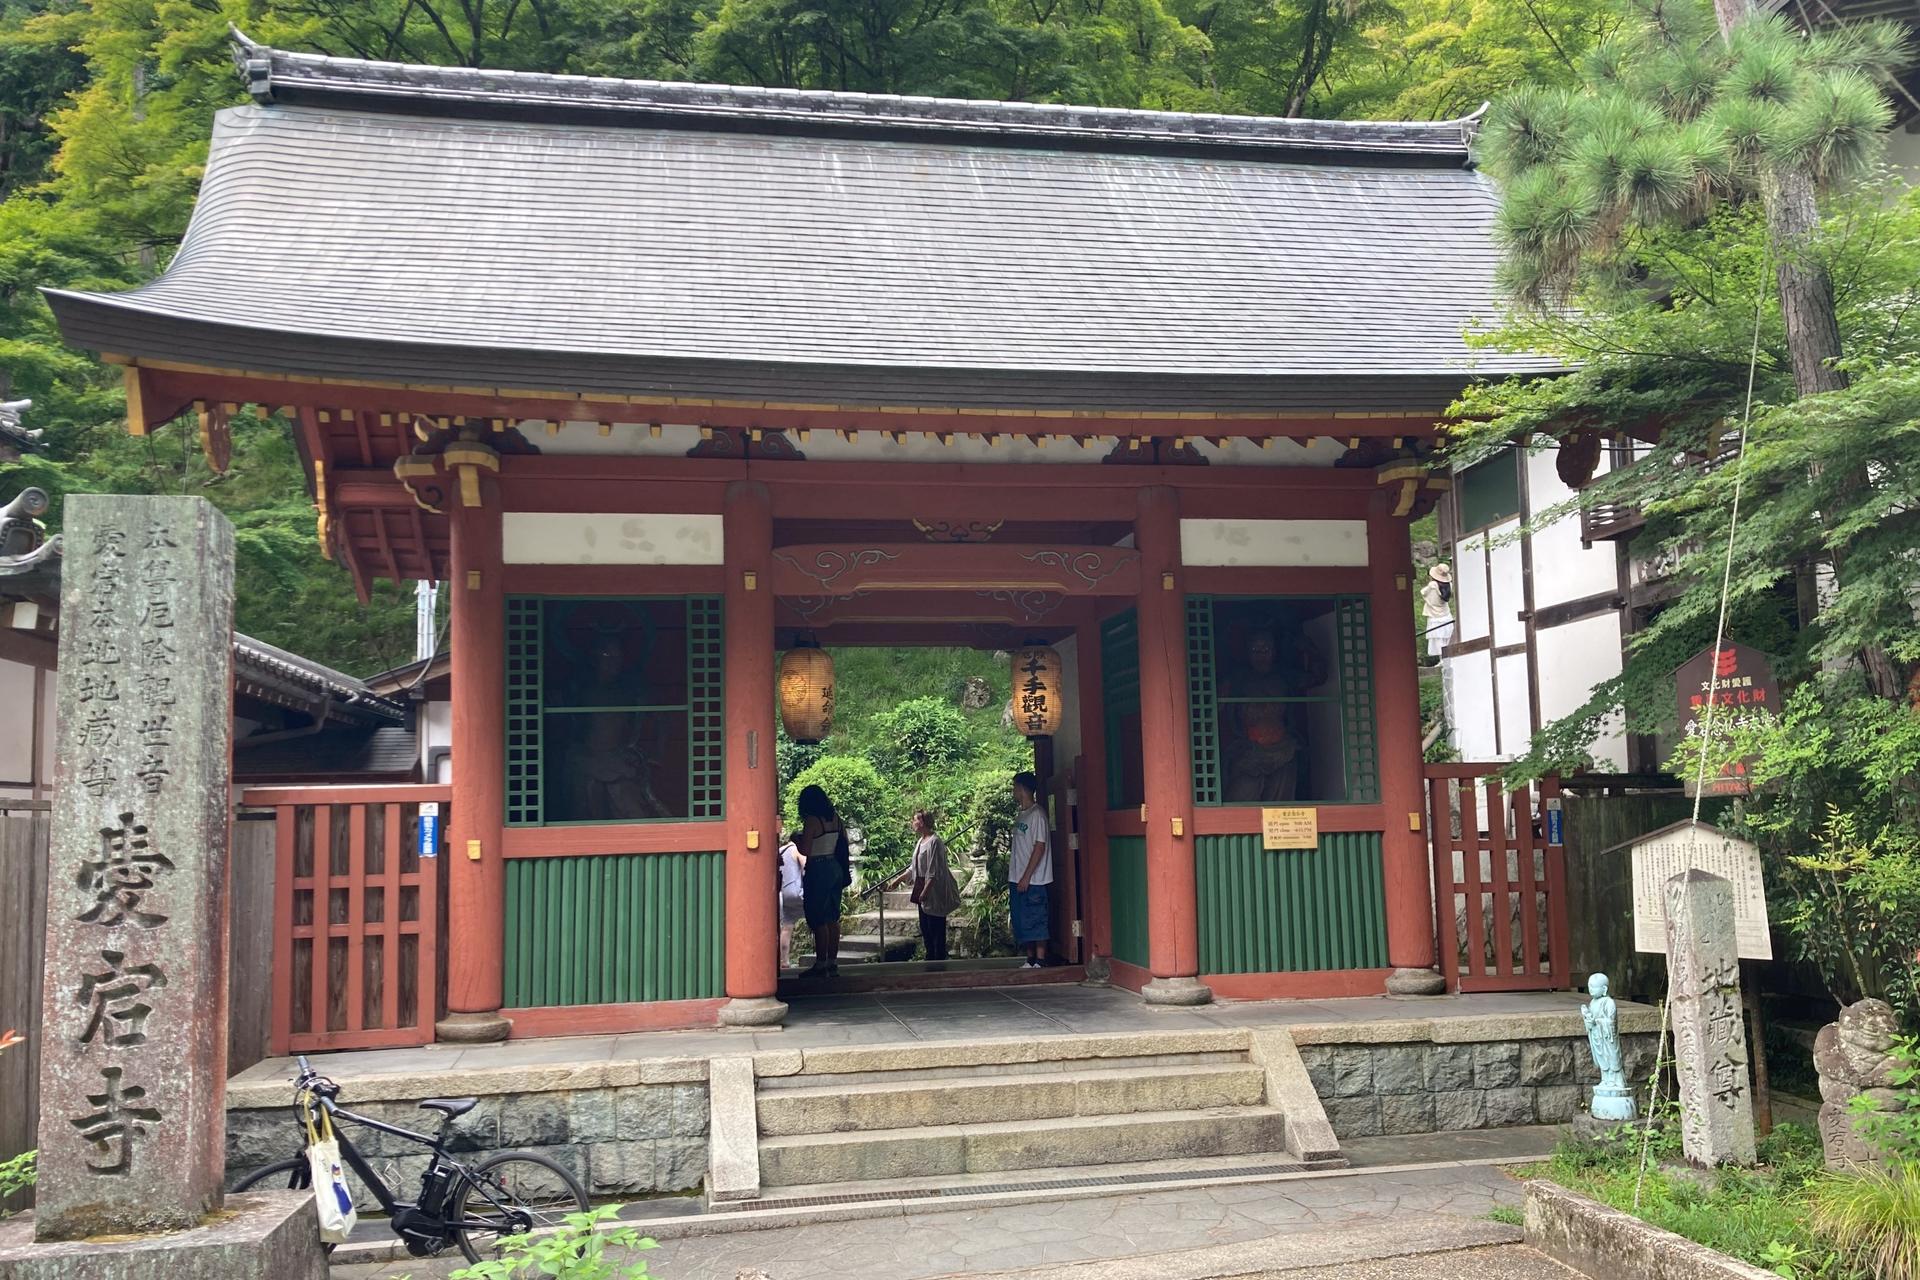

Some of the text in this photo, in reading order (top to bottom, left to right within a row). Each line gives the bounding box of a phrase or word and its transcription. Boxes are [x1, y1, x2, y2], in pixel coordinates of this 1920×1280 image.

[1712, 781, 1756, 794] HITAC
[69, 811, 176, 1177] 愛宕寺
